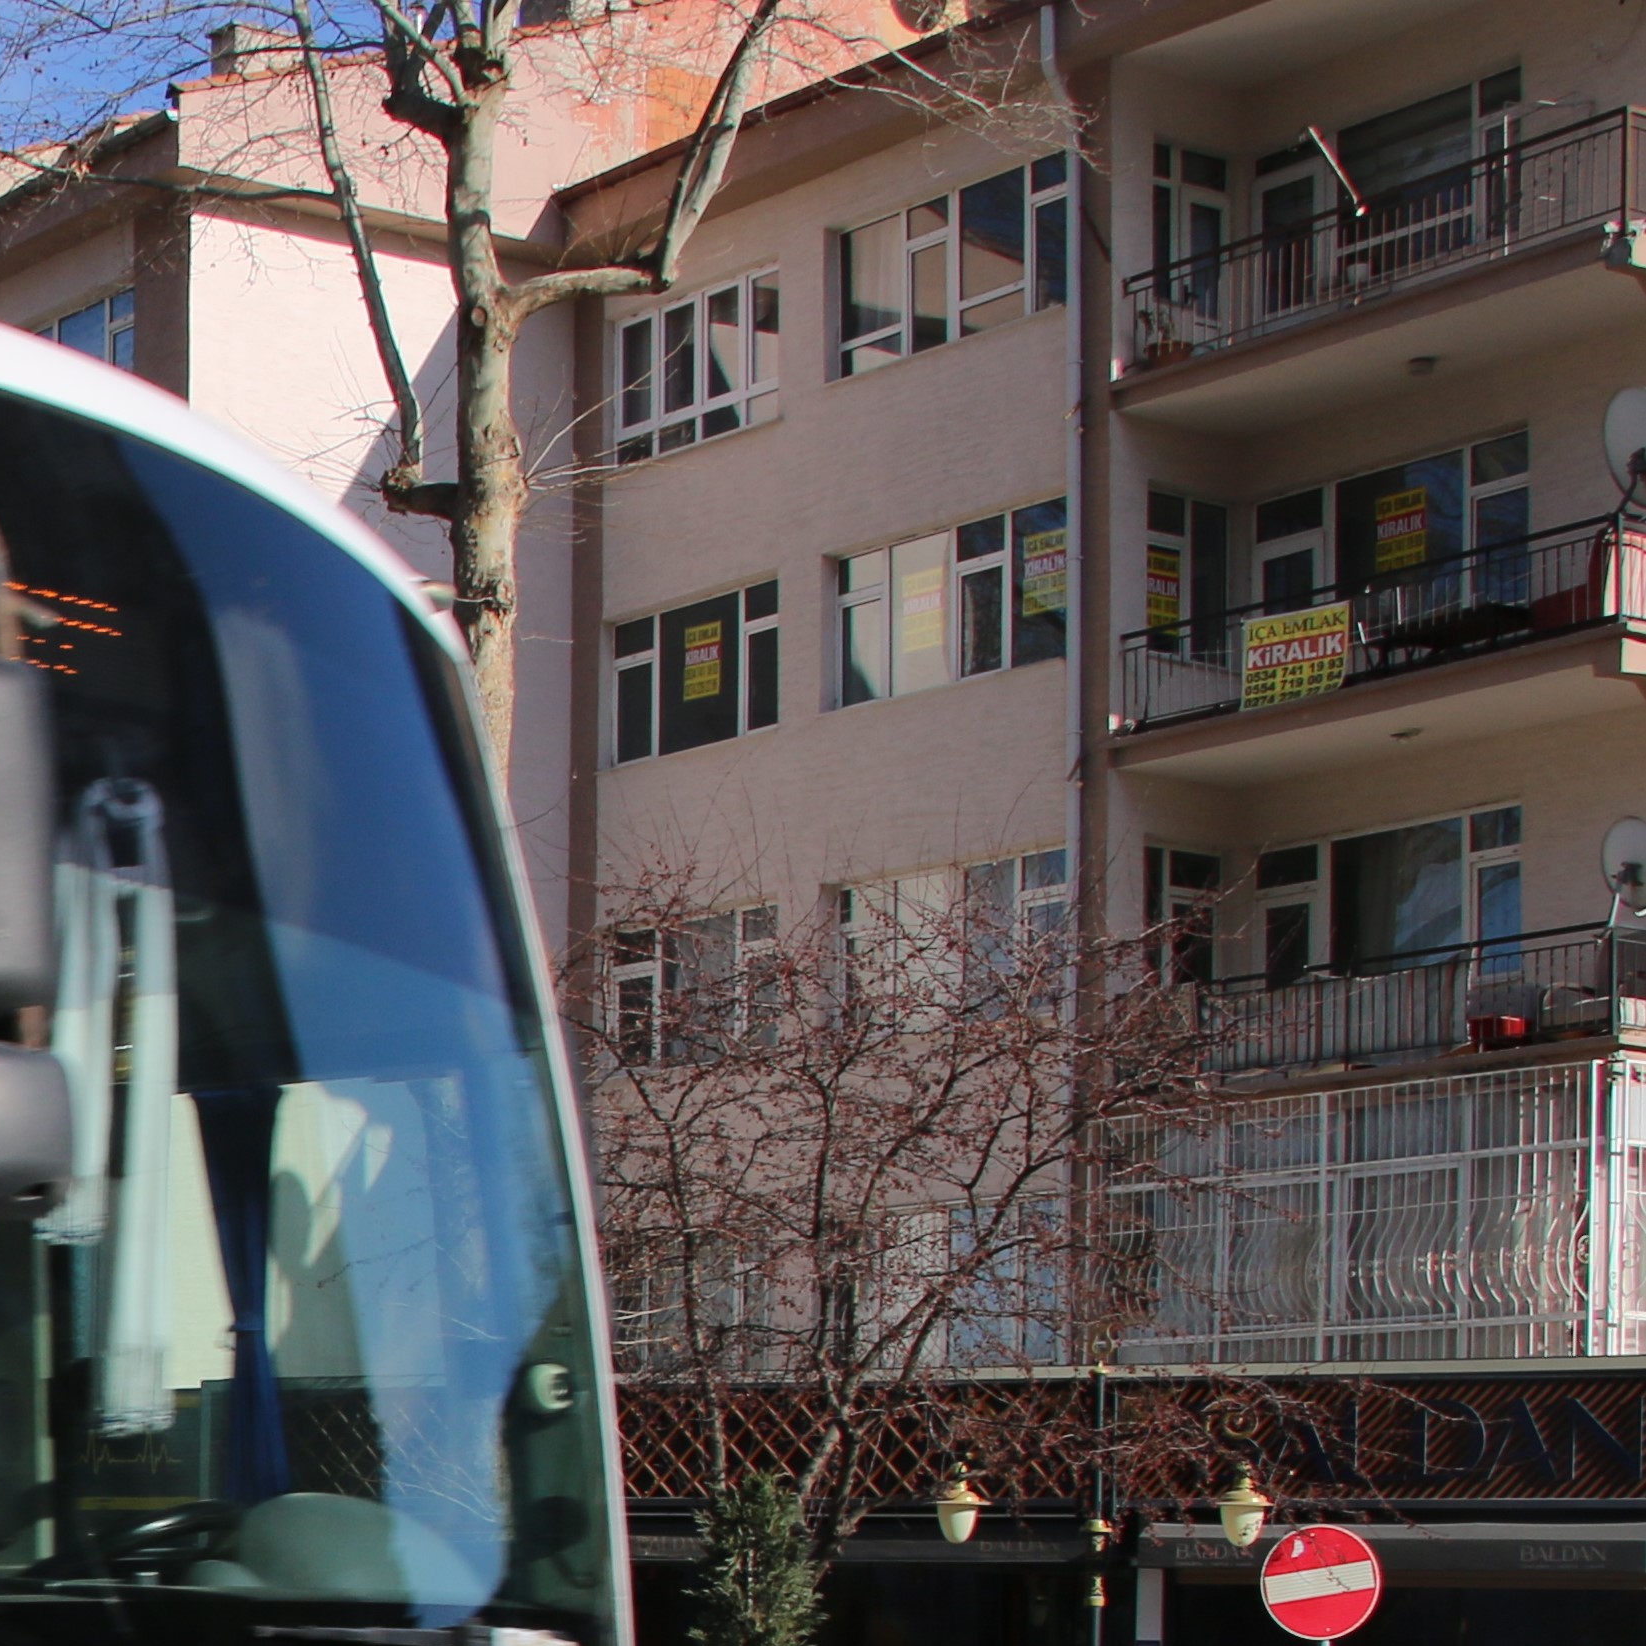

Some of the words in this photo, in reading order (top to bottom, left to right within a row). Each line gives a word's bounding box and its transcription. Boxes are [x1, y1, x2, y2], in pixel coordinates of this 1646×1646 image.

[1146, 577, 1178, 597] RALIK
[1249, 623, 1277, 644] İÇA
[1282, 610, 1346, 635] EMLAK
[1247, 633, 1344, 669] KİRALIK
[1246, 669, 1277, 684] 0534
[1281, 664, 1304, 678] 741
[1310, 661, 1324, 673] 19
[1245, 682, 1276, 696] 0554
[1519, 1545, 1607, 1562] BALDAN
